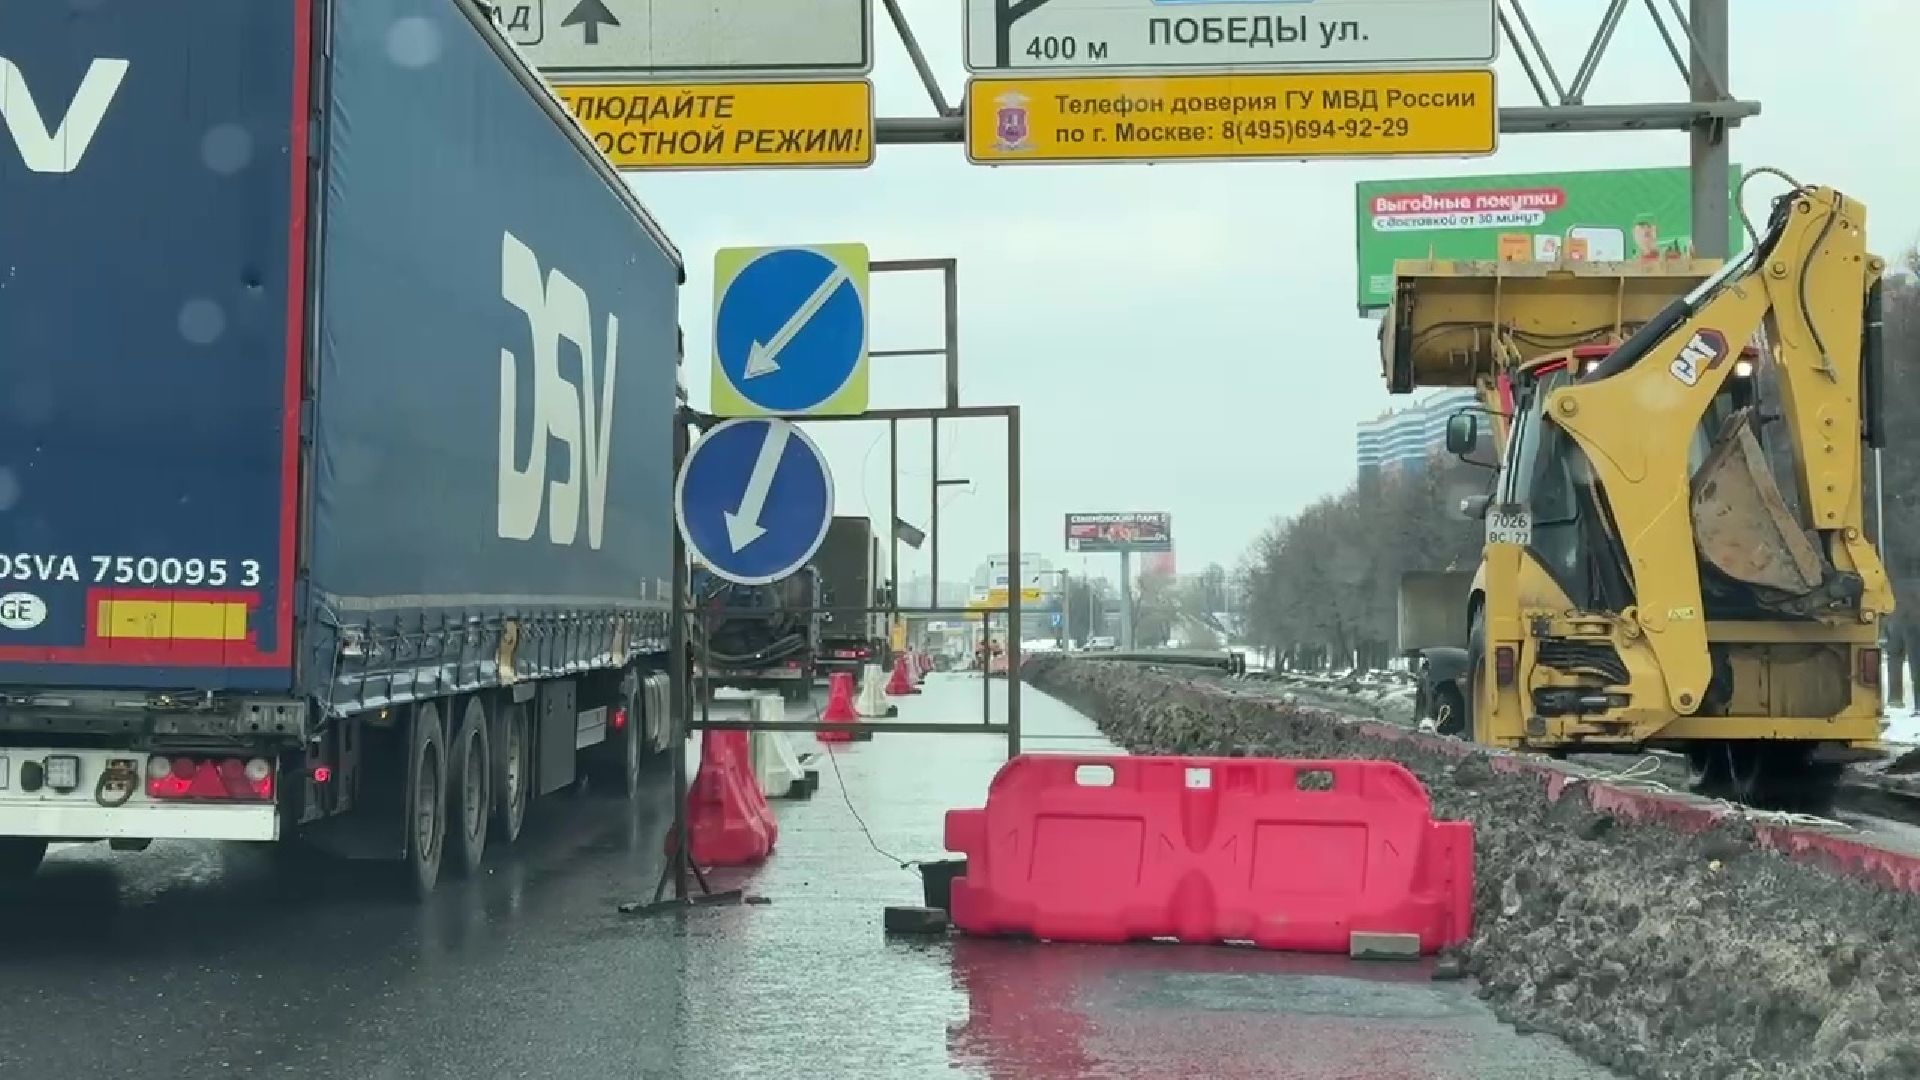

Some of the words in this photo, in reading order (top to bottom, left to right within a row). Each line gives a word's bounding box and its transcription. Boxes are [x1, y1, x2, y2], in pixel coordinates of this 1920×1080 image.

[1148, 14, 1306, 49] ПОБЕДЫ
[1319, 20, 1369, 48] ул.
[1025, 35, 1076, 60] 400
[1087, 40, 1109, 59] м
[570, 90, 736, 126] ЛЮДАЙТЕ
[1055, 93, 1164, 117] Телефон
[1170, 95, 1276, 115] доверия
[1285, 90, 1315, 110] ГУ
[1322, 89, 1379, 112] МВД
[1386, 89, 1475, 109] России
[594, 124, 726, 155] ОСТНОЙ
[733, 128, 863, 154] РЕЖИМ!
[1056, 127, 1085, 142] по
[1093, 127, 1108, 142] г.
[1115, 122, 1213, 142] Москве:
[1221, 117, 1409, 145] 8(495)694-92-29
[1376, 194, 1471, 212] Выгодные
[1475, 191, 1559, 211] покупки
[1386, 214, 1457, 228] доставкой
[1460, 216, 1475, 225] от
[1478, 213, 1493, 224] 30
[1496, 213, 1541, 227] минут
[1669, 332, 1718, 387] CAT
[498, 230, 619, 551] DSV
[1491, 513, 1528, 529] 7026
[1, 599, 32, 622] GE
